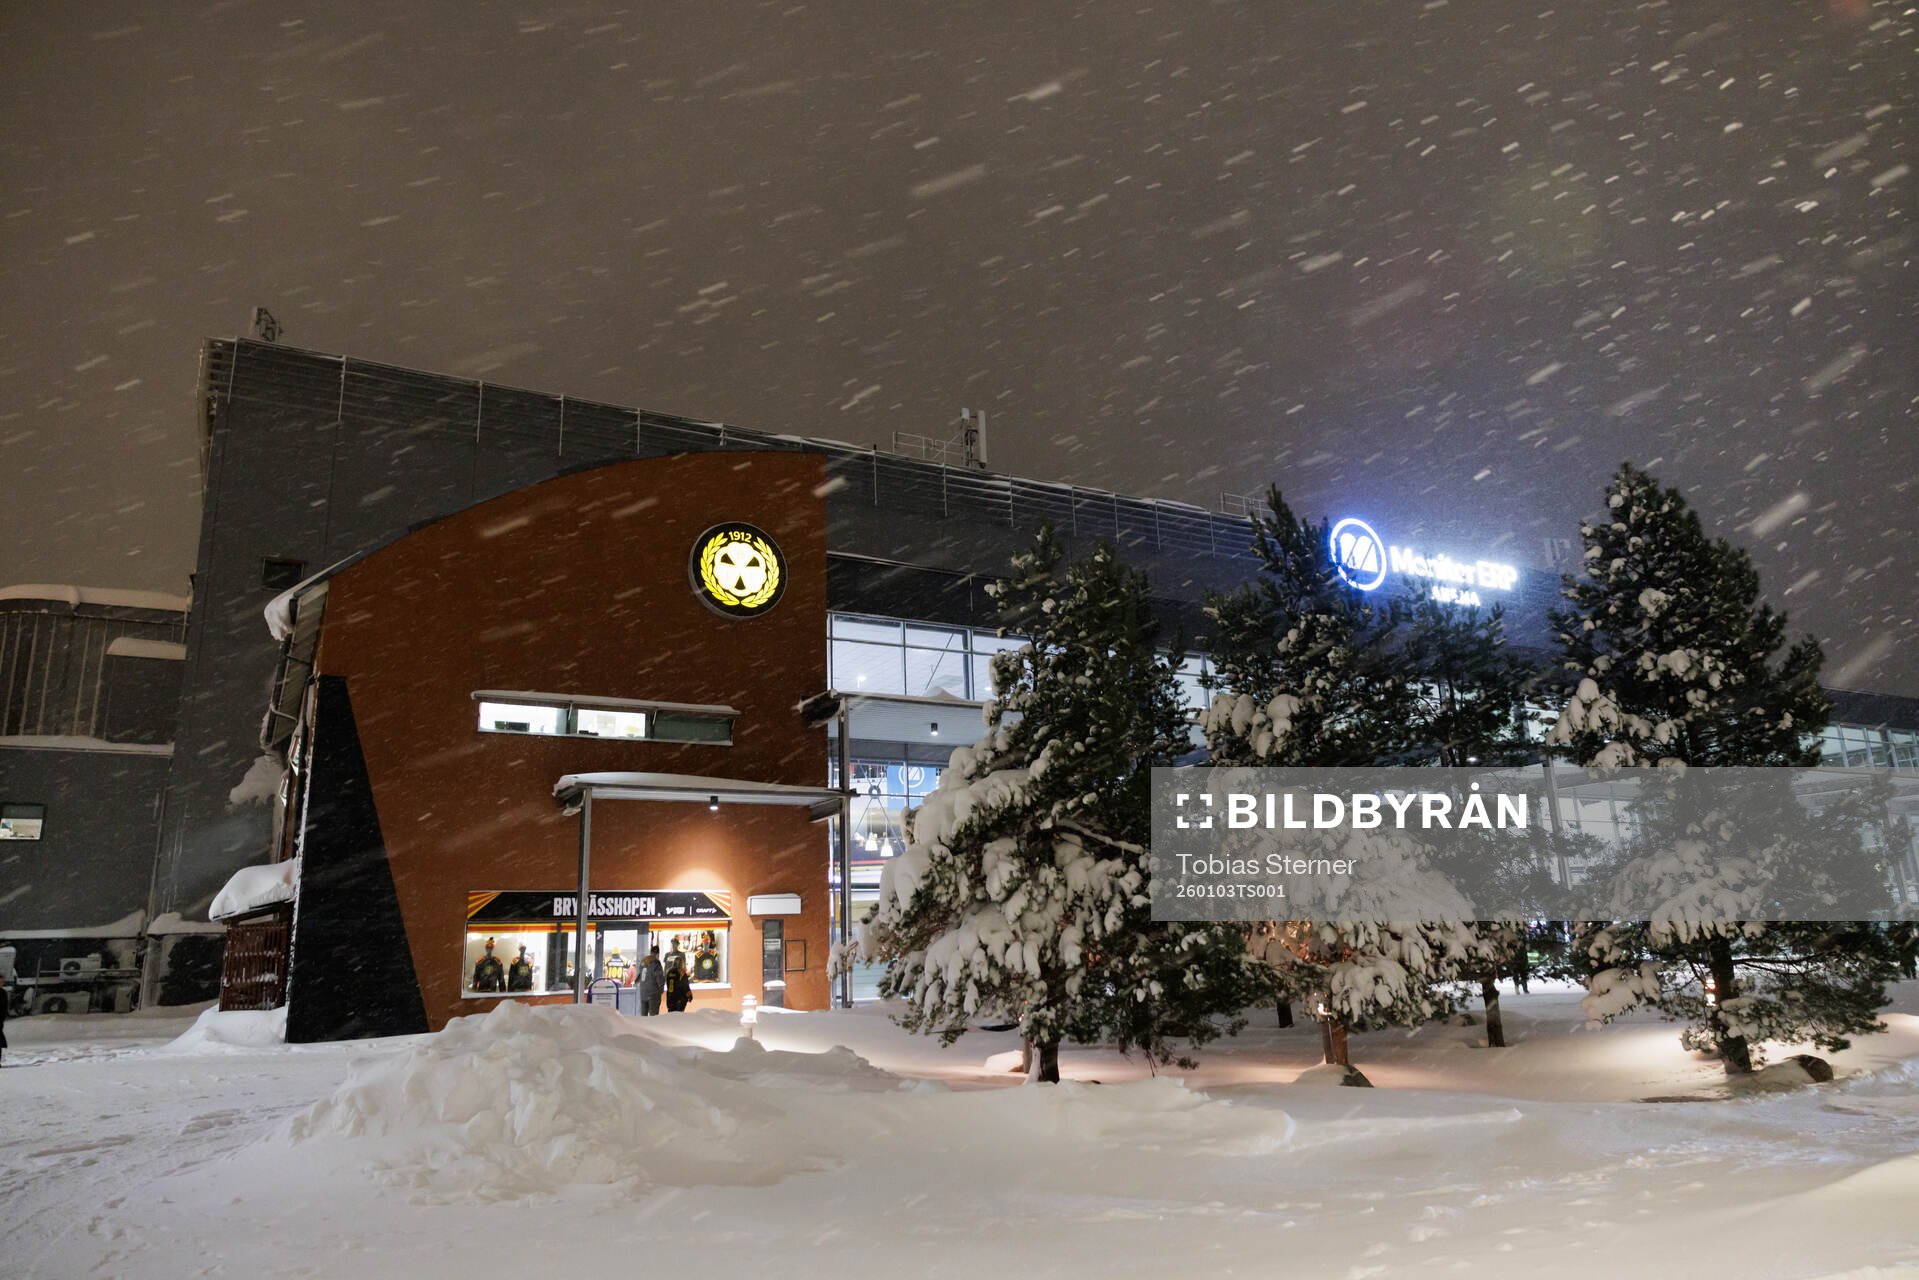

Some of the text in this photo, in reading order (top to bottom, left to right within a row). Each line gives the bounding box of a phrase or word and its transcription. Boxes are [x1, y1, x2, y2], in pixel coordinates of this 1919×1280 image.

[728, 530, 752, 543] 1912
[1476, 560, 1518, 591] ERP
[553, 894, 656, 917] BRYÄSSHOPEN
